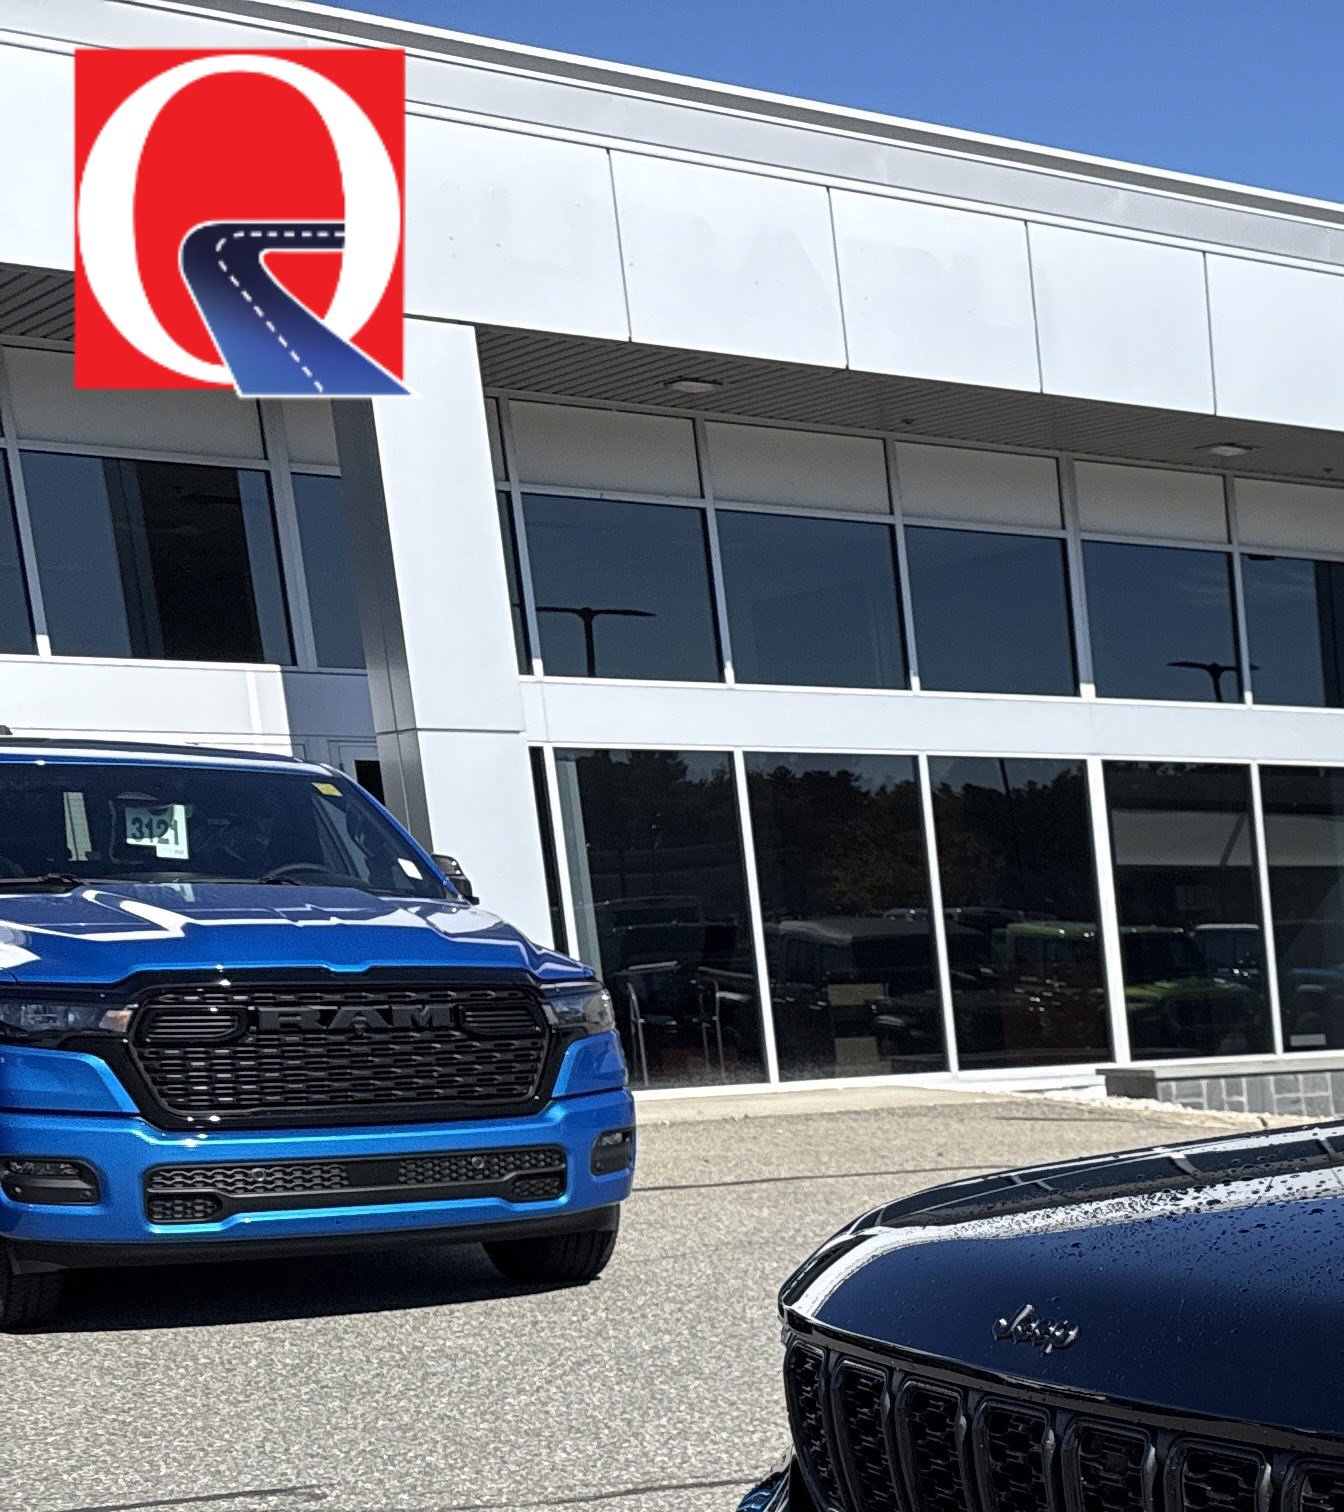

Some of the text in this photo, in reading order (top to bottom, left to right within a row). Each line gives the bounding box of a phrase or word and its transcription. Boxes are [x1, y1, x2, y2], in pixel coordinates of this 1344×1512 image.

[130, 816, 180, 846] 3121
[256, 1003, 456, 1031] RAM
[992, 1303, 1080, 1355] Jeep
